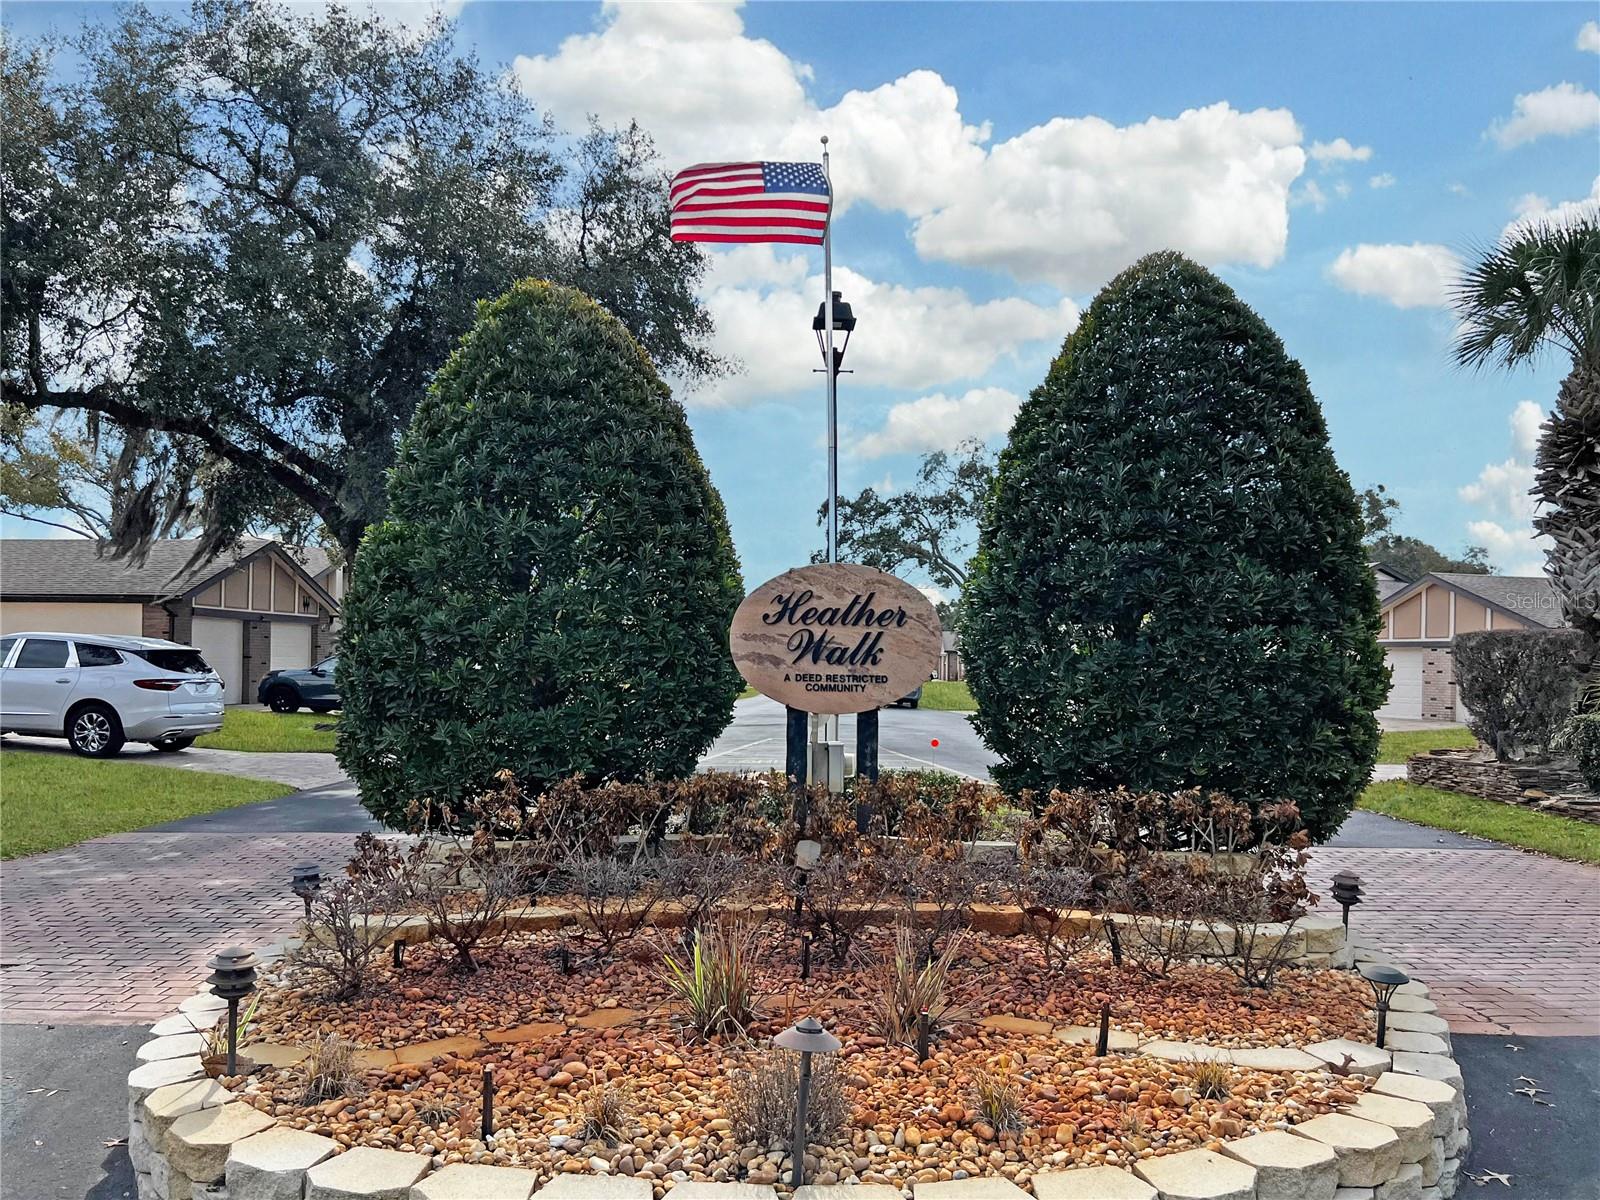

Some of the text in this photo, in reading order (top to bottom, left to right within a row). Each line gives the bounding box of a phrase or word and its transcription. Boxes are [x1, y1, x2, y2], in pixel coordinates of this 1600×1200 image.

[762, 590, 908, 628] Heather
[786, 628, 885, 666] Walk
[784, 673, 889, 684] A DEED RESTRICTED
[805, 683, 866, 693] COMMUNITY
